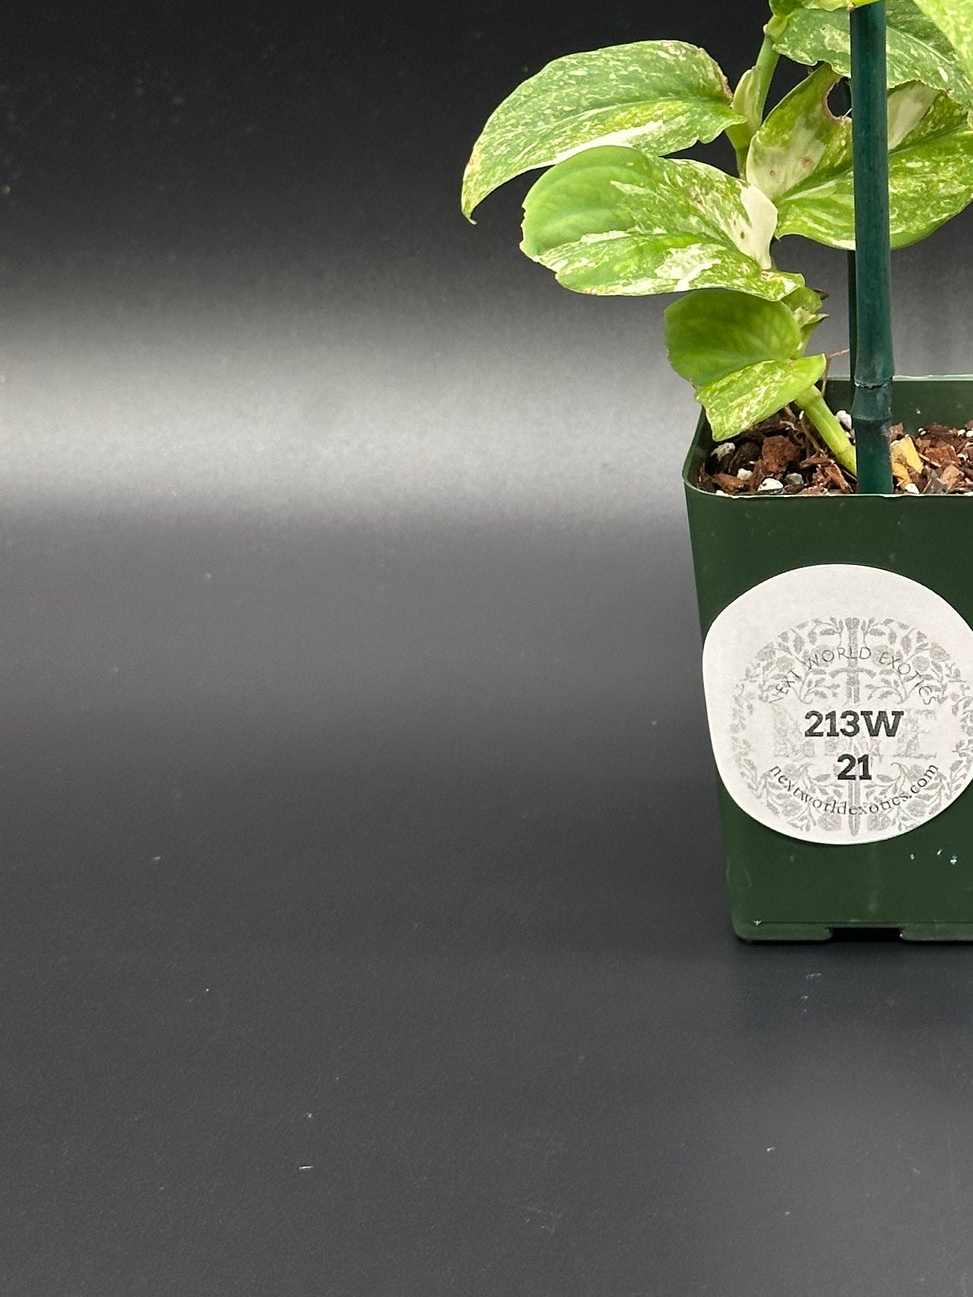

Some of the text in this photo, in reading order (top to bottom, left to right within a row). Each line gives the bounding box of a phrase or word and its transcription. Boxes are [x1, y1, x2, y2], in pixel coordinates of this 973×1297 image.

[768, 645, 937, 706] NEXT WORLD EXOTICS
[803, 709, 905, 738] 213W
[836, 752, 873, 781] 21
[769, 762, 939, 816] nextworldexotics.com
